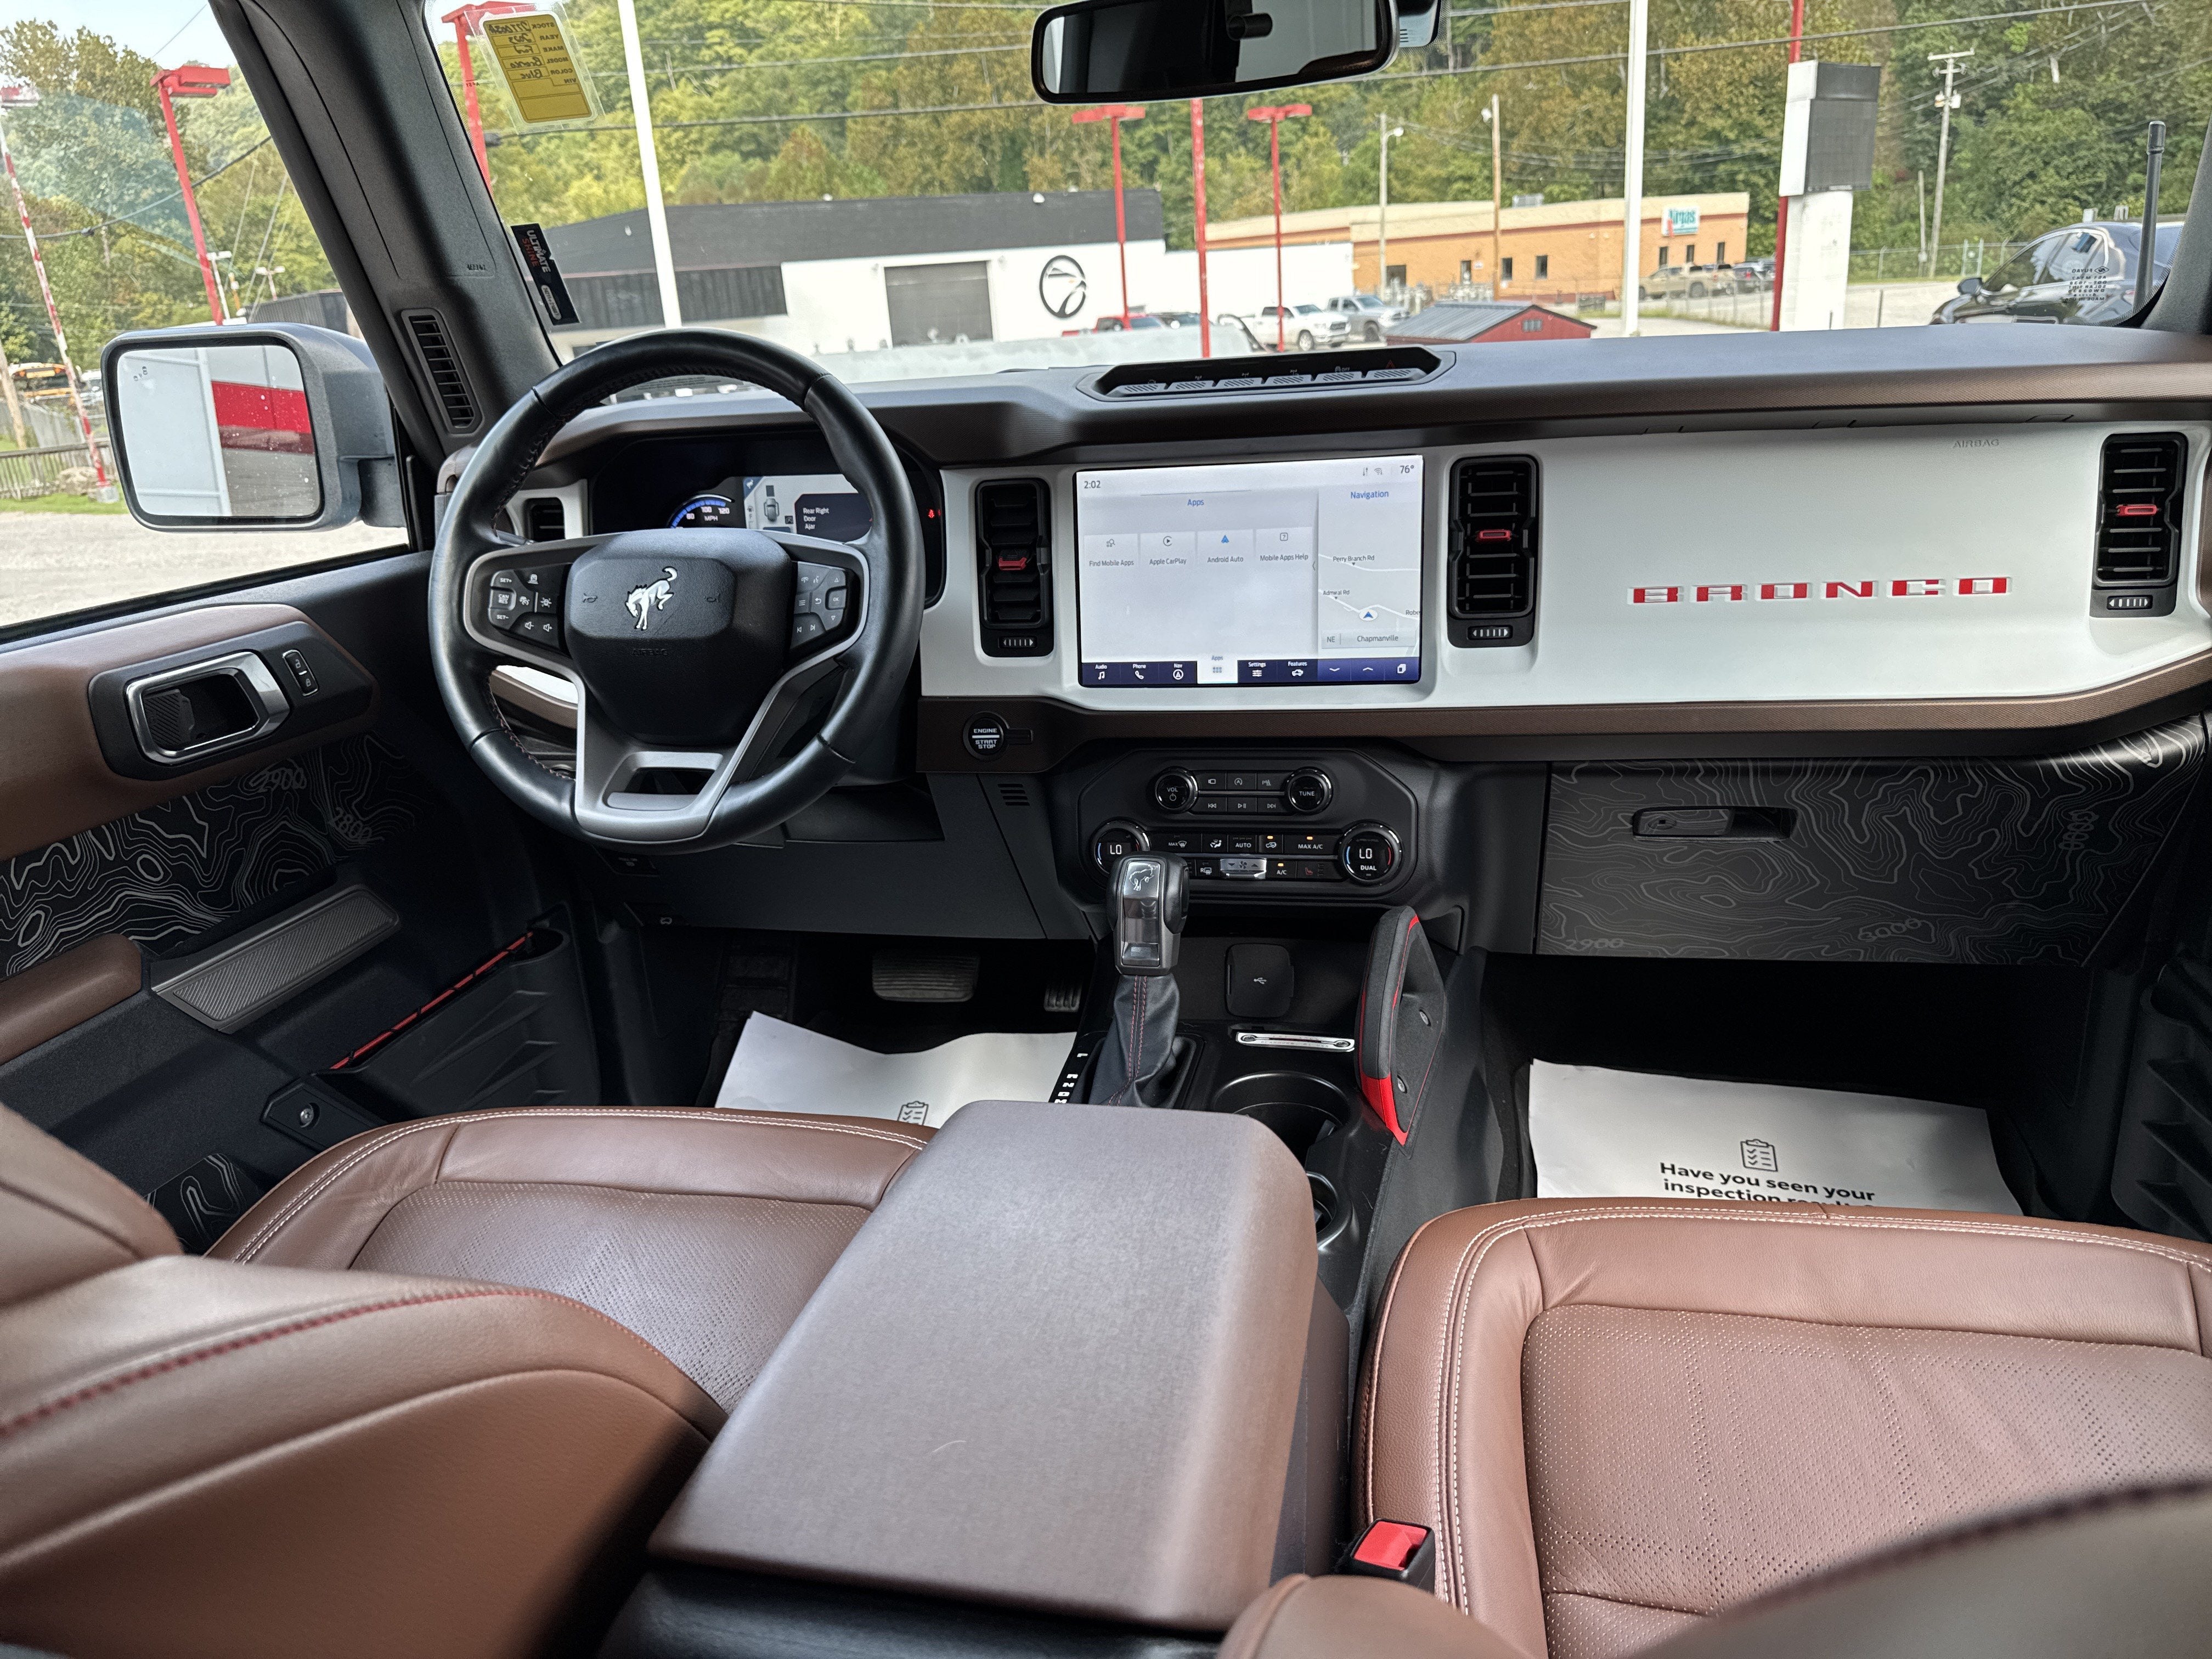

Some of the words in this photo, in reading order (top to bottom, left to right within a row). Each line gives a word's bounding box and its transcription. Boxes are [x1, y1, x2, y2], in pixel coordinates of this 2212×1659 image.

[522, 238, 540, 267] SHINE
[527, 230, 551, 273] ULTIMATE
[1953, 439, 1999, 448] AIRBAG
[1400, 465, 1414, 474] 76°
[1084, 481, 1101, 489] 2:02
[1351, 490, 1389, 500] Navigation
[1187, 499, 1205, 507] Apps
[815, 507, 830, 515] Right
[1629, 577, 2011, 604] BRONCO
[1357, 634, 1398, 643] Chapmanville
[1110, 844, 1122, 855] LO
[1359, 848, 1373, 859] LO
[1660, 1162, 1714, 1181] Have
[1719, 1172, 1759, 1187] you
[1767, 1179, 1818, 1194] seen
[1822, 1185, 1875, 1201] your
[1663, 1178, 1781, 1202] inspection
